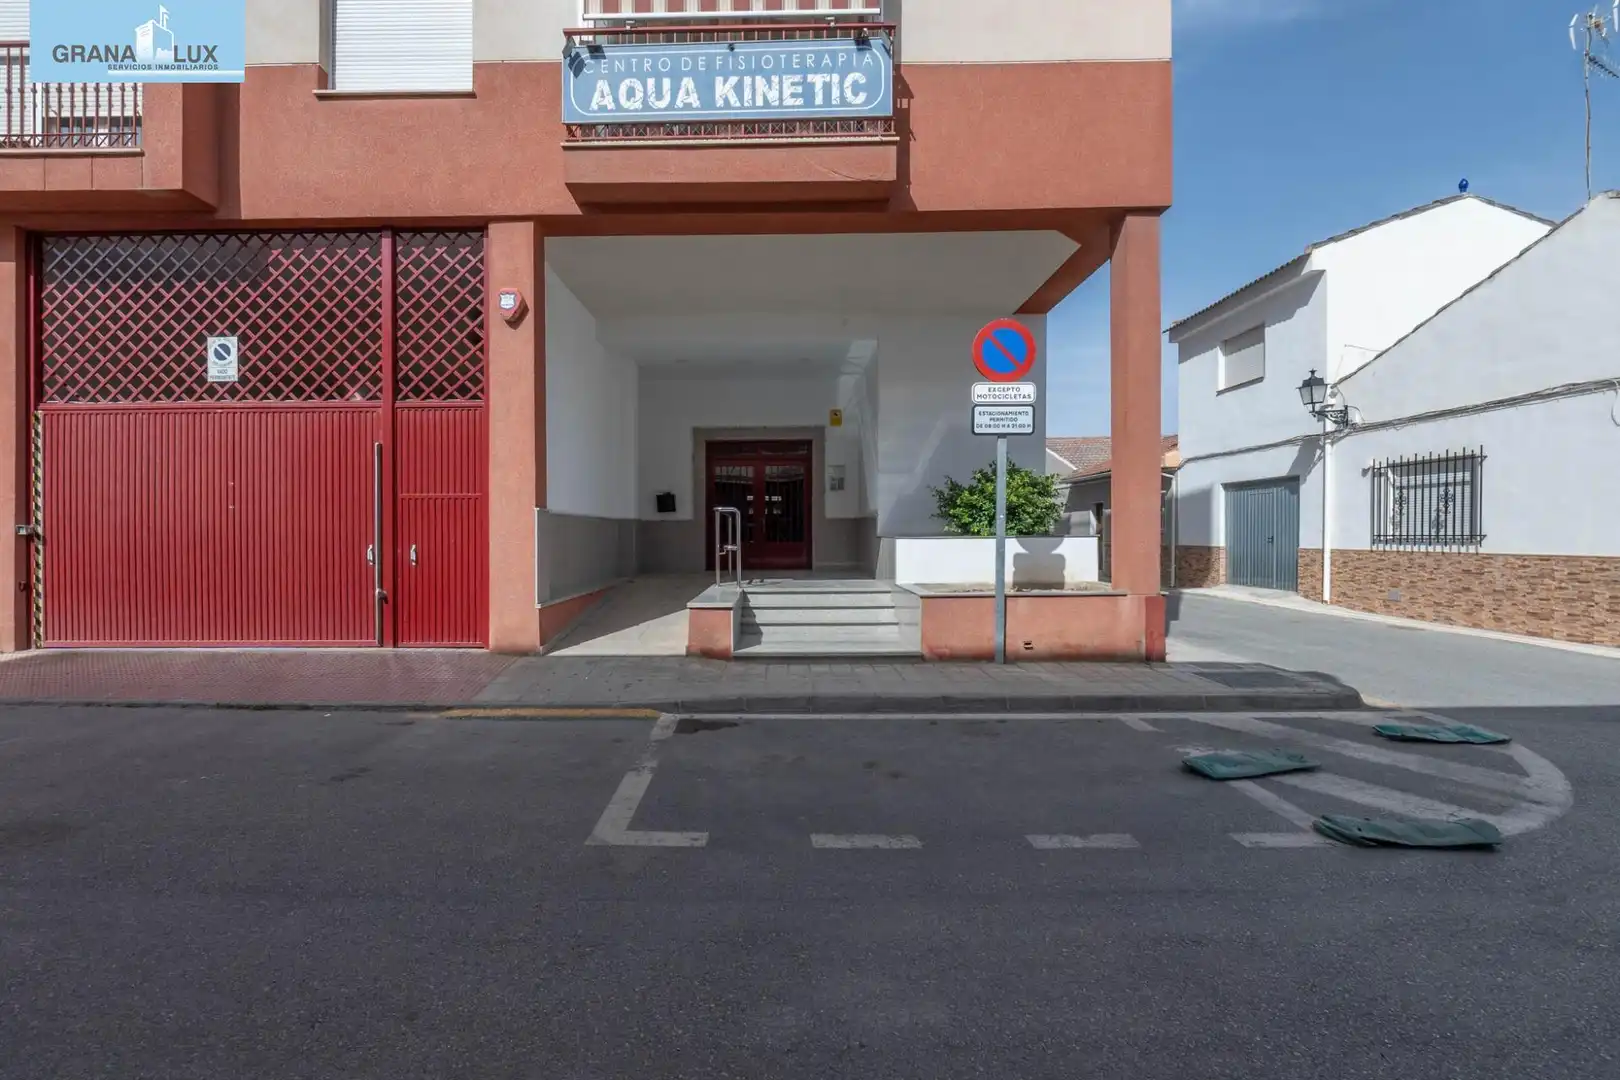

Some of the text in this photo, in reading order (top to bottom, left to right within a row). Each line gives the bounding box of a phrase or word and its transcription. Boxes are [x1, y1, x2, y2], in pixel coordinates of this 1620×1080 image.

[583, 52, 874, 74] CENTRO DE FISIOTERAPIA
[588, 72, 868, 111] AQUA KINETIC
